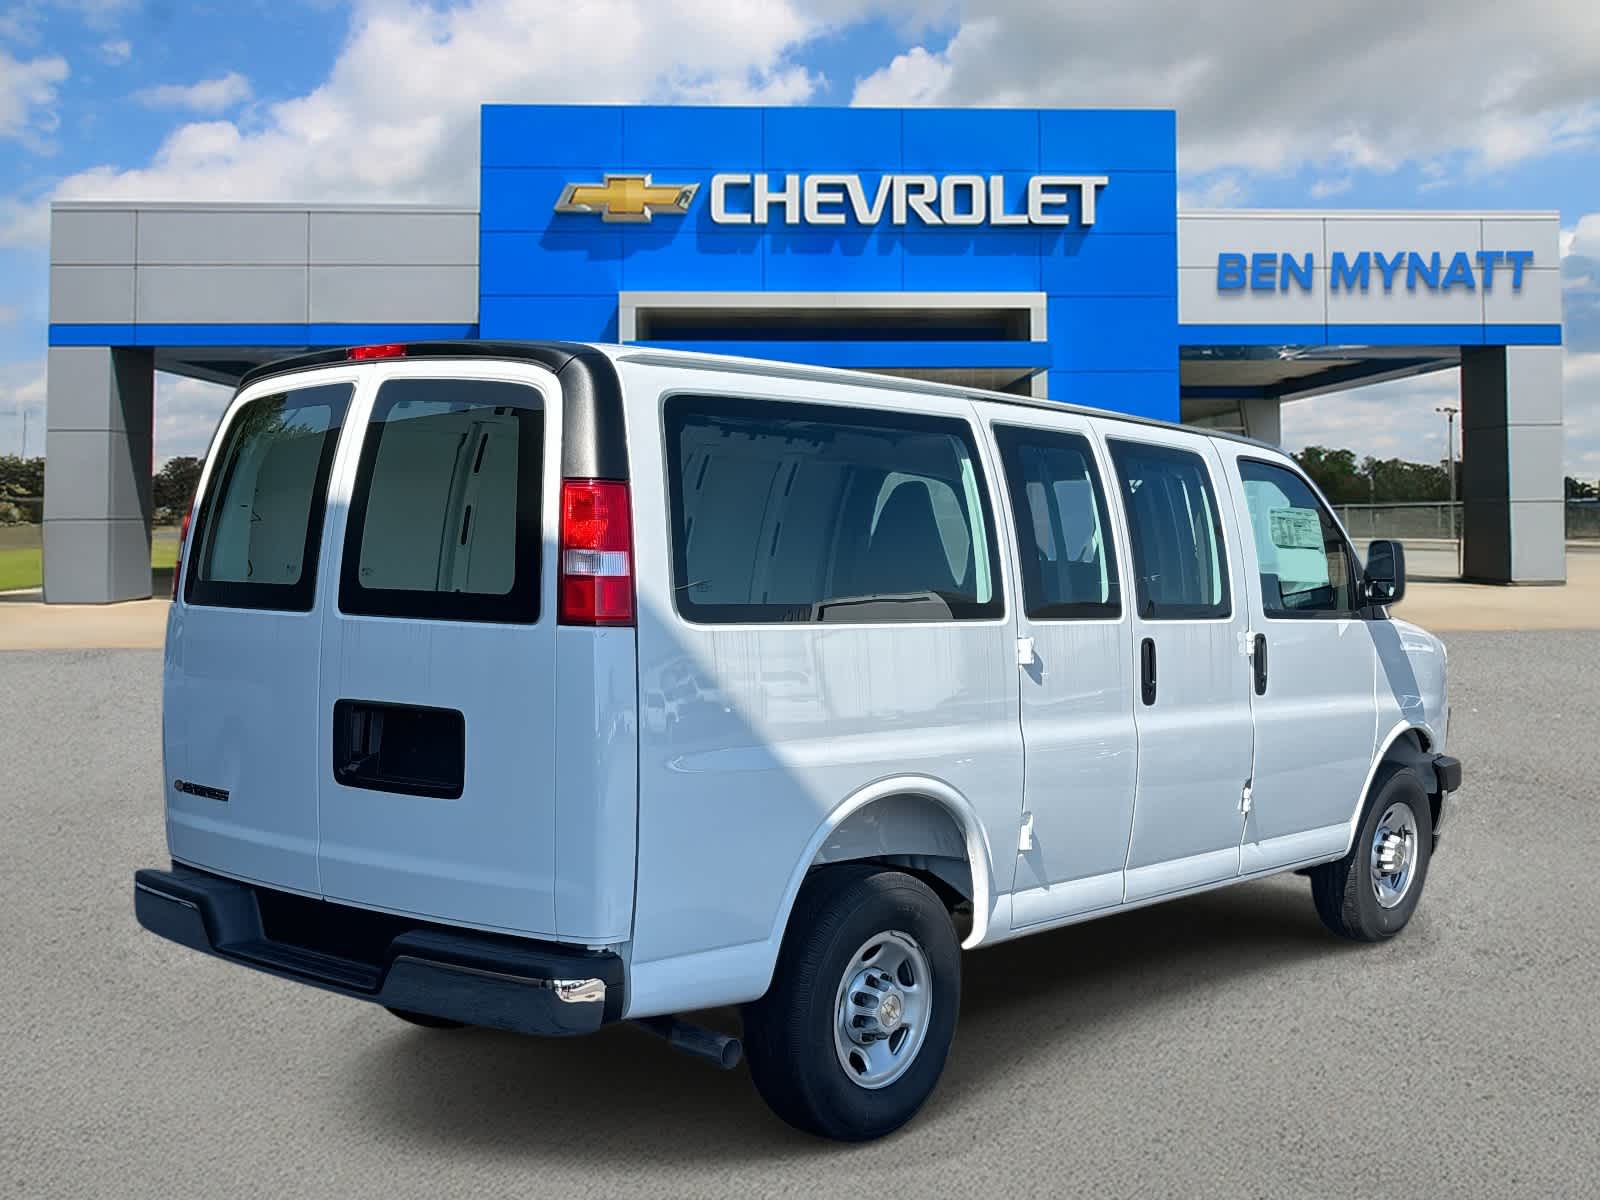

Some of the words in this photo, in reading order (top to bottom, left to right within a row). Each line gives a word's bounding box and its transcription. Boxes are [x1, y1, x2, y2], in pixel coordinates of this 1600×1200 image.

[710, 173, 1108, 225] CHEVROLET
[1217, 252, 1314, 290] BEN
[1330, 251, 1534, 290] MYNATT
